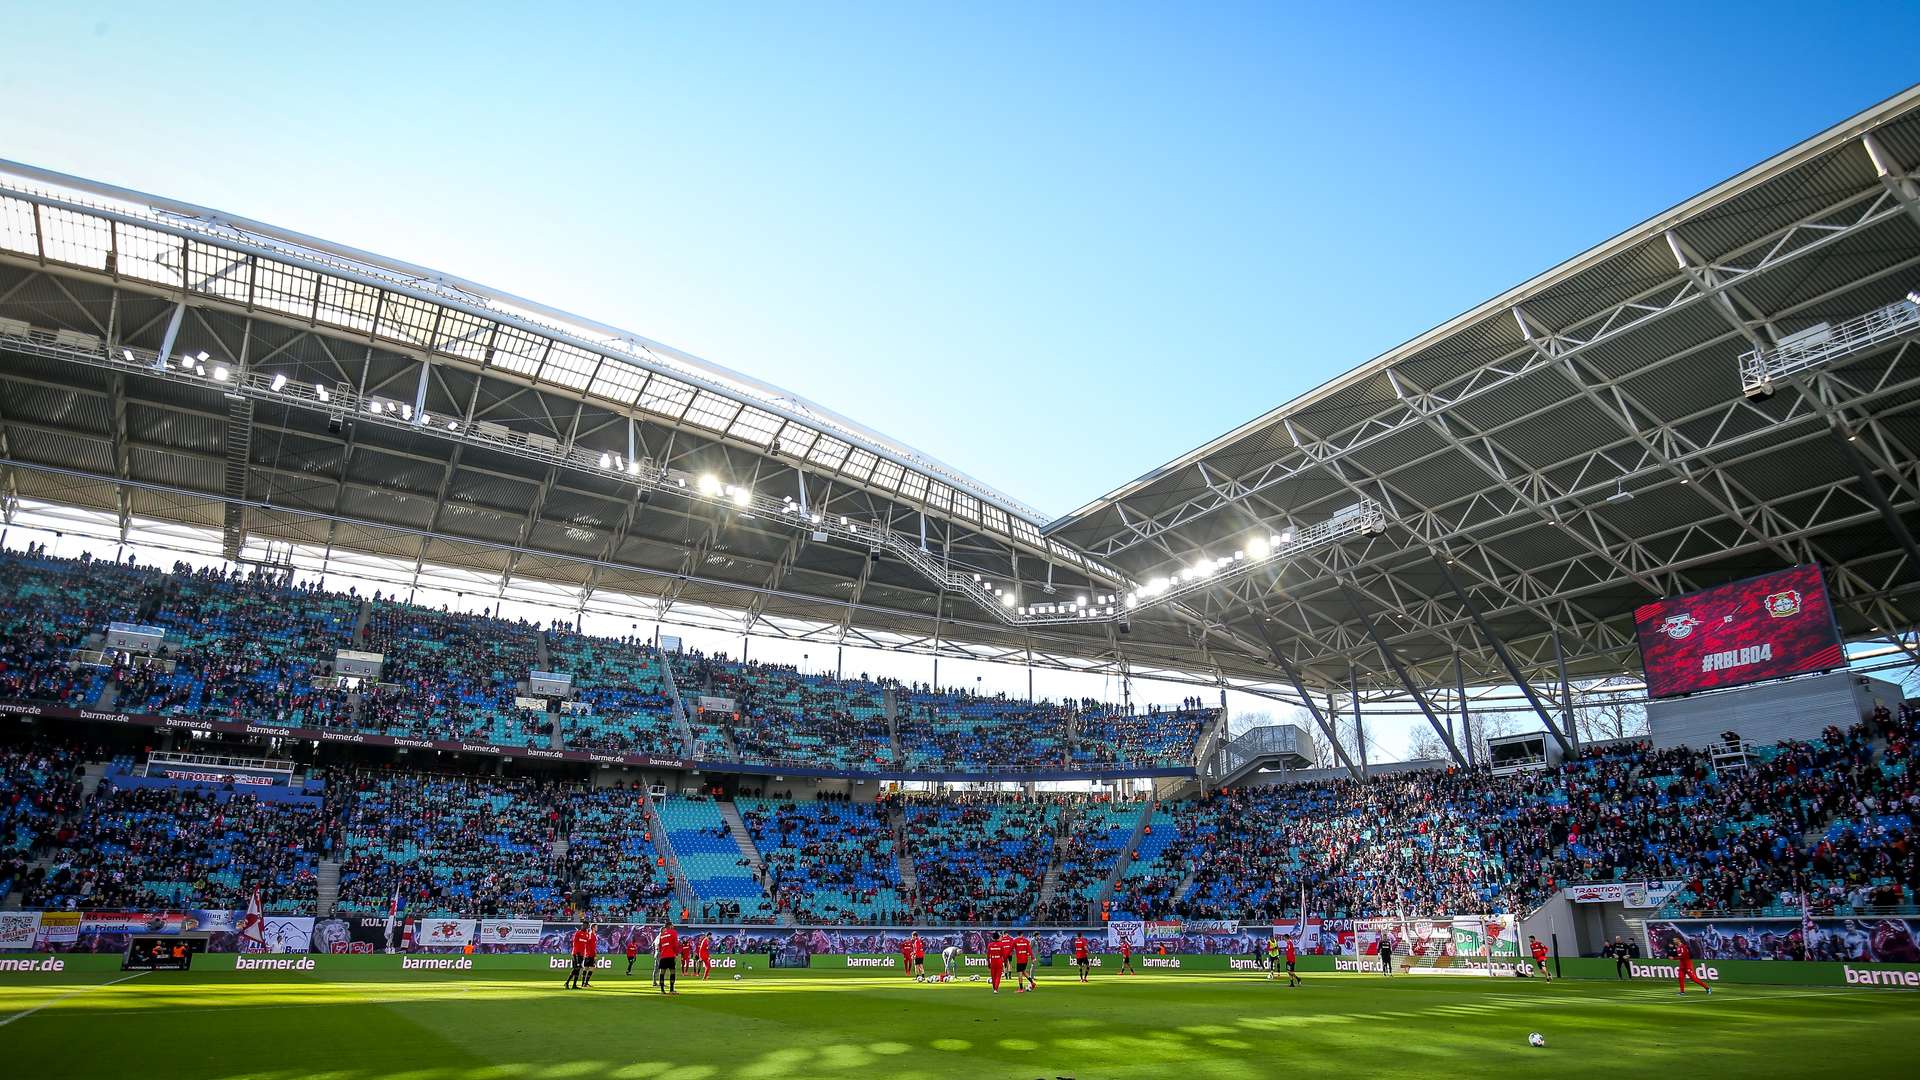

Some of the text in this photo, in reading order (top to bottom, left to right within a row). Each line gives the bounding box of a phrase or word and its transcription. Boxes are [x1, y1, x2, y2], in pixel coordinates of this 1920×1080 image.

[1702, 643, 1771, 672] #RBLB04
[80, 709, 129, 723] barmer.de
[166, 717, 212, 730] barmer.de
[246, 724, 290, 737] barmer.de
[322, 731, 364, 743] barmer.de
[394, 737, 433, 749] barmer.de
[462, 743, 500, 754] barmer.de
[527, 748, 563, 759] barmer.de
[589, 753, 624, 763] barmer.de
[649, 758, 683, 768] barmer.de
[95, 923, 129, 931] Friends
[236, 955, 315, 970] barmer.de
[402, 955, 472, 969] barmer.de
[847, 956, 895, 967] barmer.de
[1142, 956, 1180, 968] barmer.de
